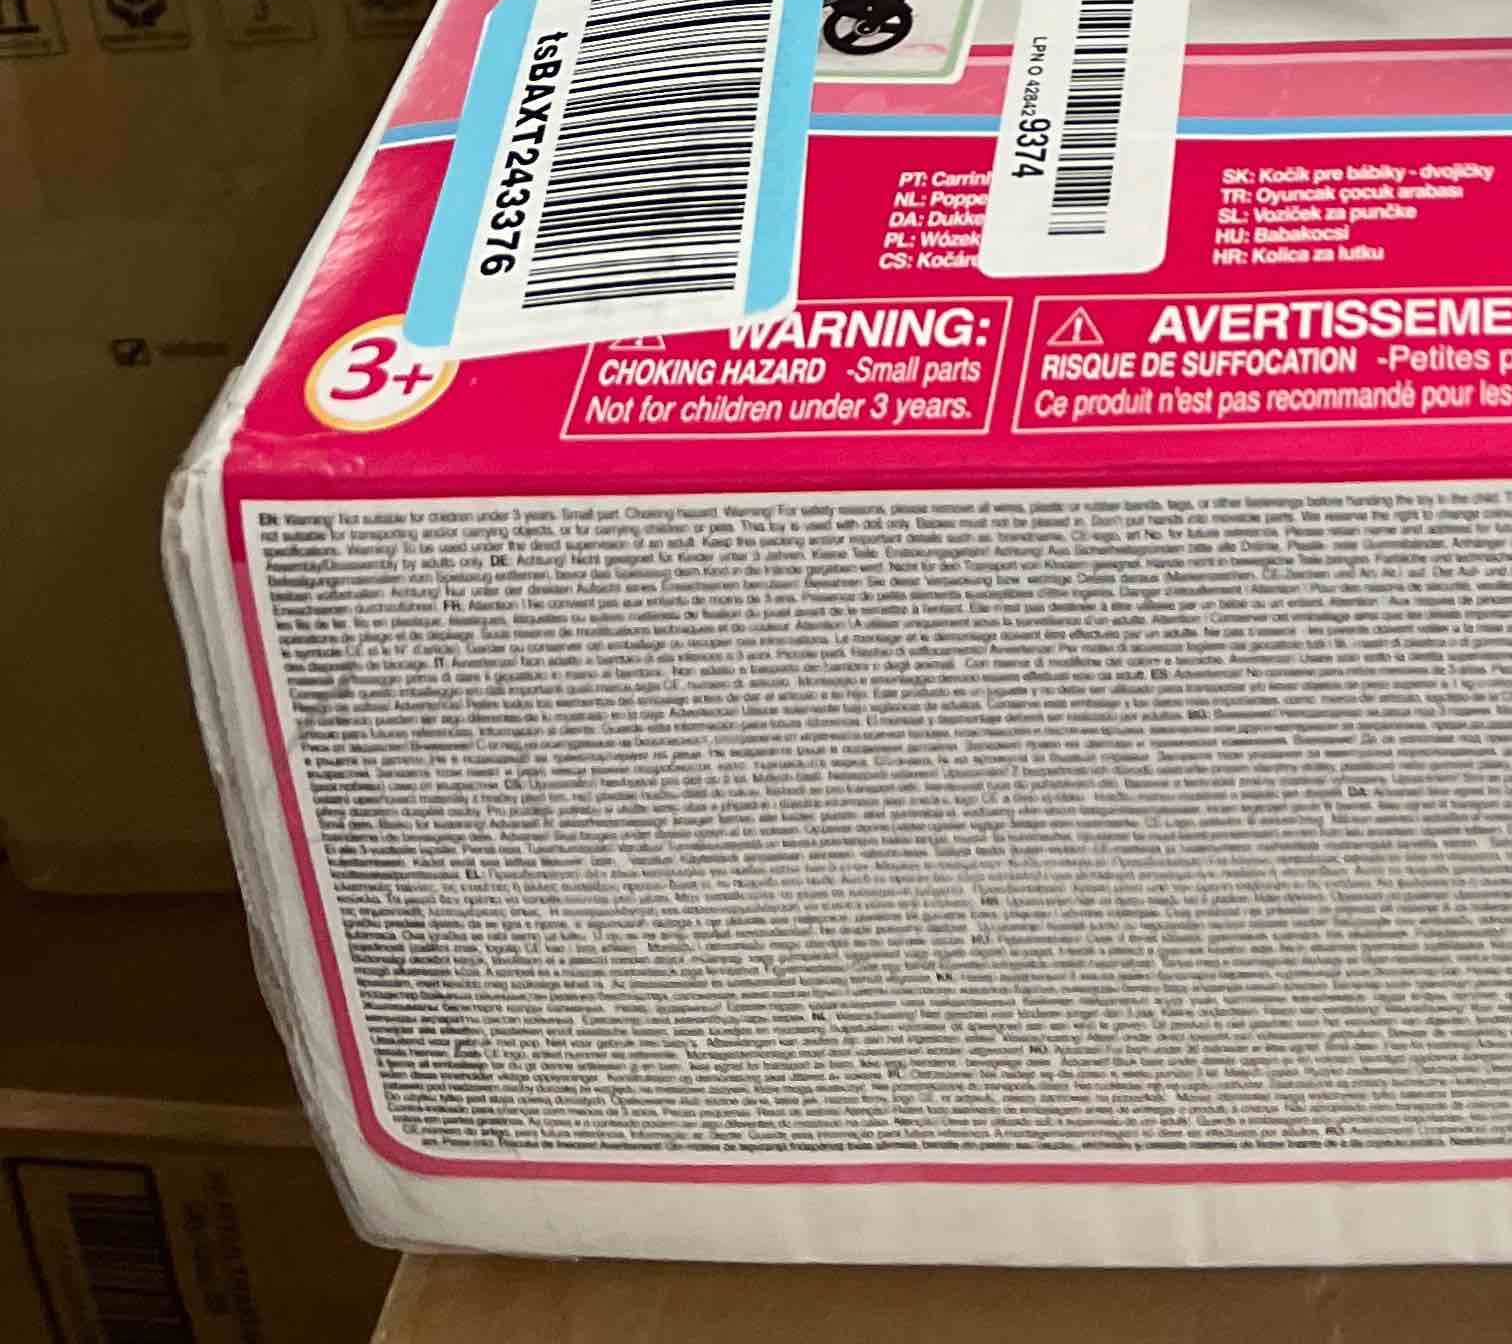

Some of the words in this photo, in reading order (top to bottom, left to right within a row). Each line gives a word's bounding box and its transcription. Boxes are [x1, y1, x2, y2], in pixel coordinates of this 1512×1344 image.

[1029, 36, 1048, 62] LPN
[480, 28, 568, 277] tsBAXT243376
[898, 171, 928, 187] PT:
[1222, 169, 1254, 185] SK:
[1313, 168, 1343, 185] pre
[894, 191, 926, 208] NL:
[1220, 188, 1253, 204] TR:
[1256, 186, 1335, 205] Oyuncak
[889, 211, 925, 227] DA:
[1218, 209, 1249, 224] SL:
[1325, 206, 1346, 220] za
[884, 231, 915, 248] PL:
[1216, 228, 1250, 244] HU:
[1253, 224, 1349, 243] Babakocsi
[879, 253, 913, 269] CS:
[1212, 249, 1248, 265] HR:
[1252, 246, 1309, 263] Kolica
[1313, 247, 1334, 261] za
[1338, 245, 1384, 260] lutku
[729, 308, 991, 350] WARNING:
[330, 336, 434, 401] 3+
[598, 359, 716, 386] CHOKING
[721, 357, 827, 385] HAZARD
[922, 357, 982, 388] parts
[1041, 353, 1136, 381] RISQUE
[1140, 352, 1177, 379] DE
[1181, 346, 1357, 377] SUFFOCATION
[585, 396, 633, 424] Not
[639, 396, 676, 423] for
[680, 394, 783, 422] children
[788, 393, 867, 421] under
[869, 393, 889, 419] 3
[893, 395, 973, 425] years.
[1034, 389, 1069, 419] Ce
[1072, 387, 1153, 422] produit
[1158, 386, 1214, 415] n'est
[1217, 389, 1260, 419] pas
[1266, 380, 1415, 412] recommandé
[1421, 384, 1475, 414] pour
